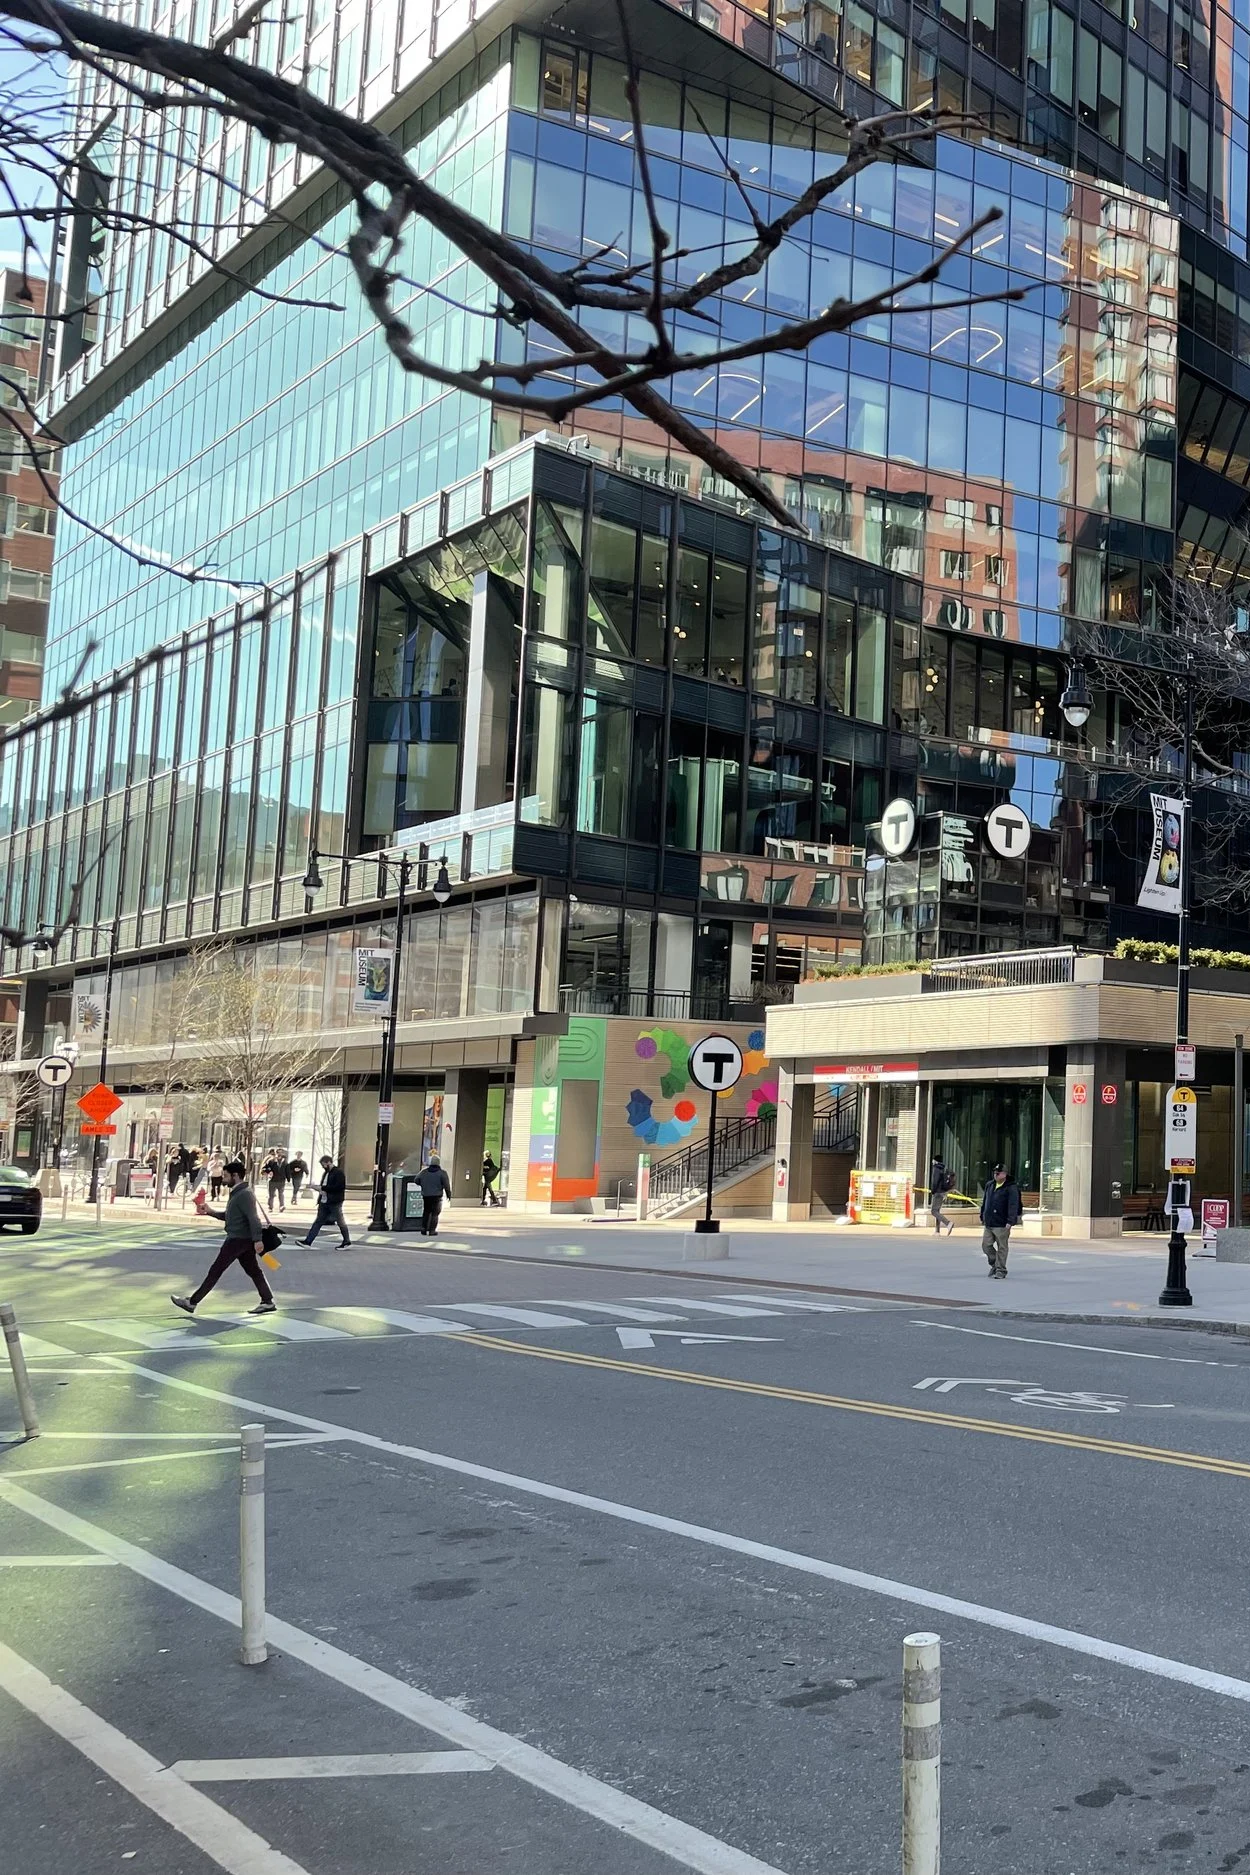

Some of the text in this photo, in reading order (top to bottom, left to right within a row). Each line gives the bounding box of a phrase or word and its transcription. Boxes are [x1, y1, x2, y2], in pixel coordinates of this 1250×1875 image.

[1152, 795, 1167, 809] MIT
[888, 813, 908, 845] T
[996, 817, 1023, 848] T
[45, 1065, 66, 1081] T
[703, 1053, 734, 1083] T
